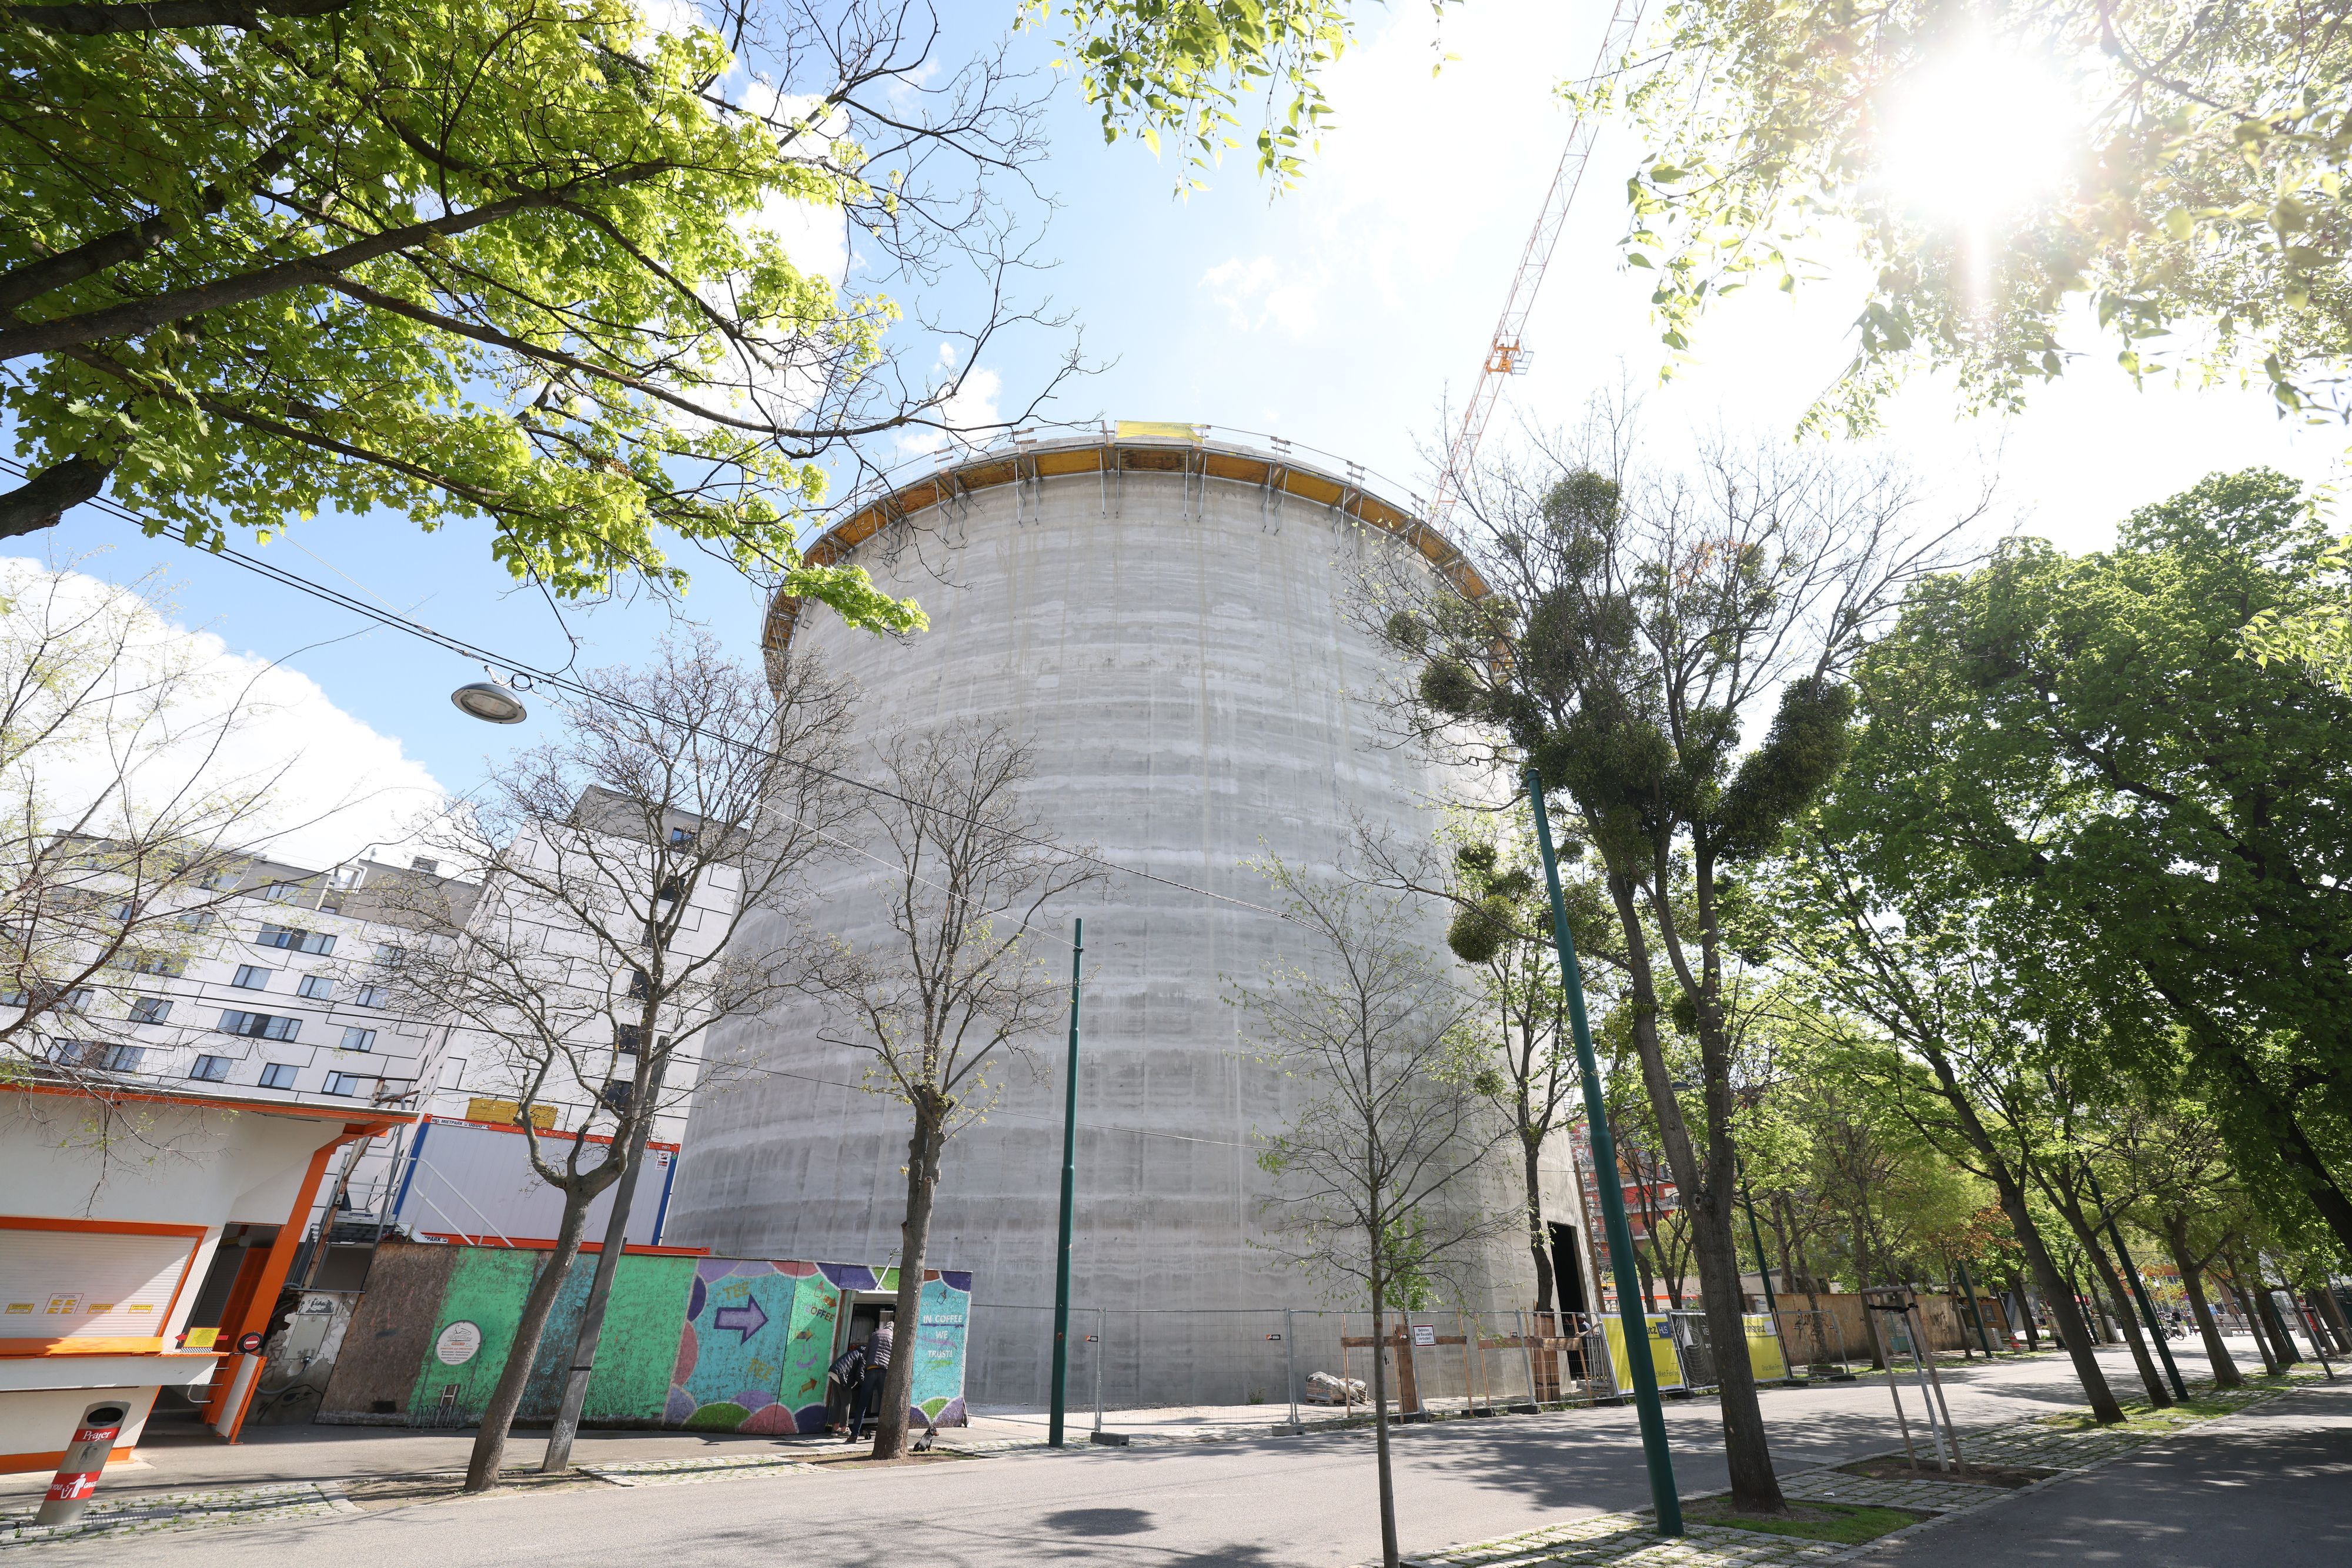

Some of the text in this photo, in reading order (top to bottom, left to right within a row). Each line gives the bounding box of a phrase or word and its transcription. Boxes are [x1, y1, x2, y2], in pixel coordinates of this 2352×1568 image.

[723, 1281, 749, 1300] TEE
[805, 1305, 836, 1322] COFFEE
[923, 1315, 963, 1323] IN COFFEE
[936, 1330, 948, 1339] WE
